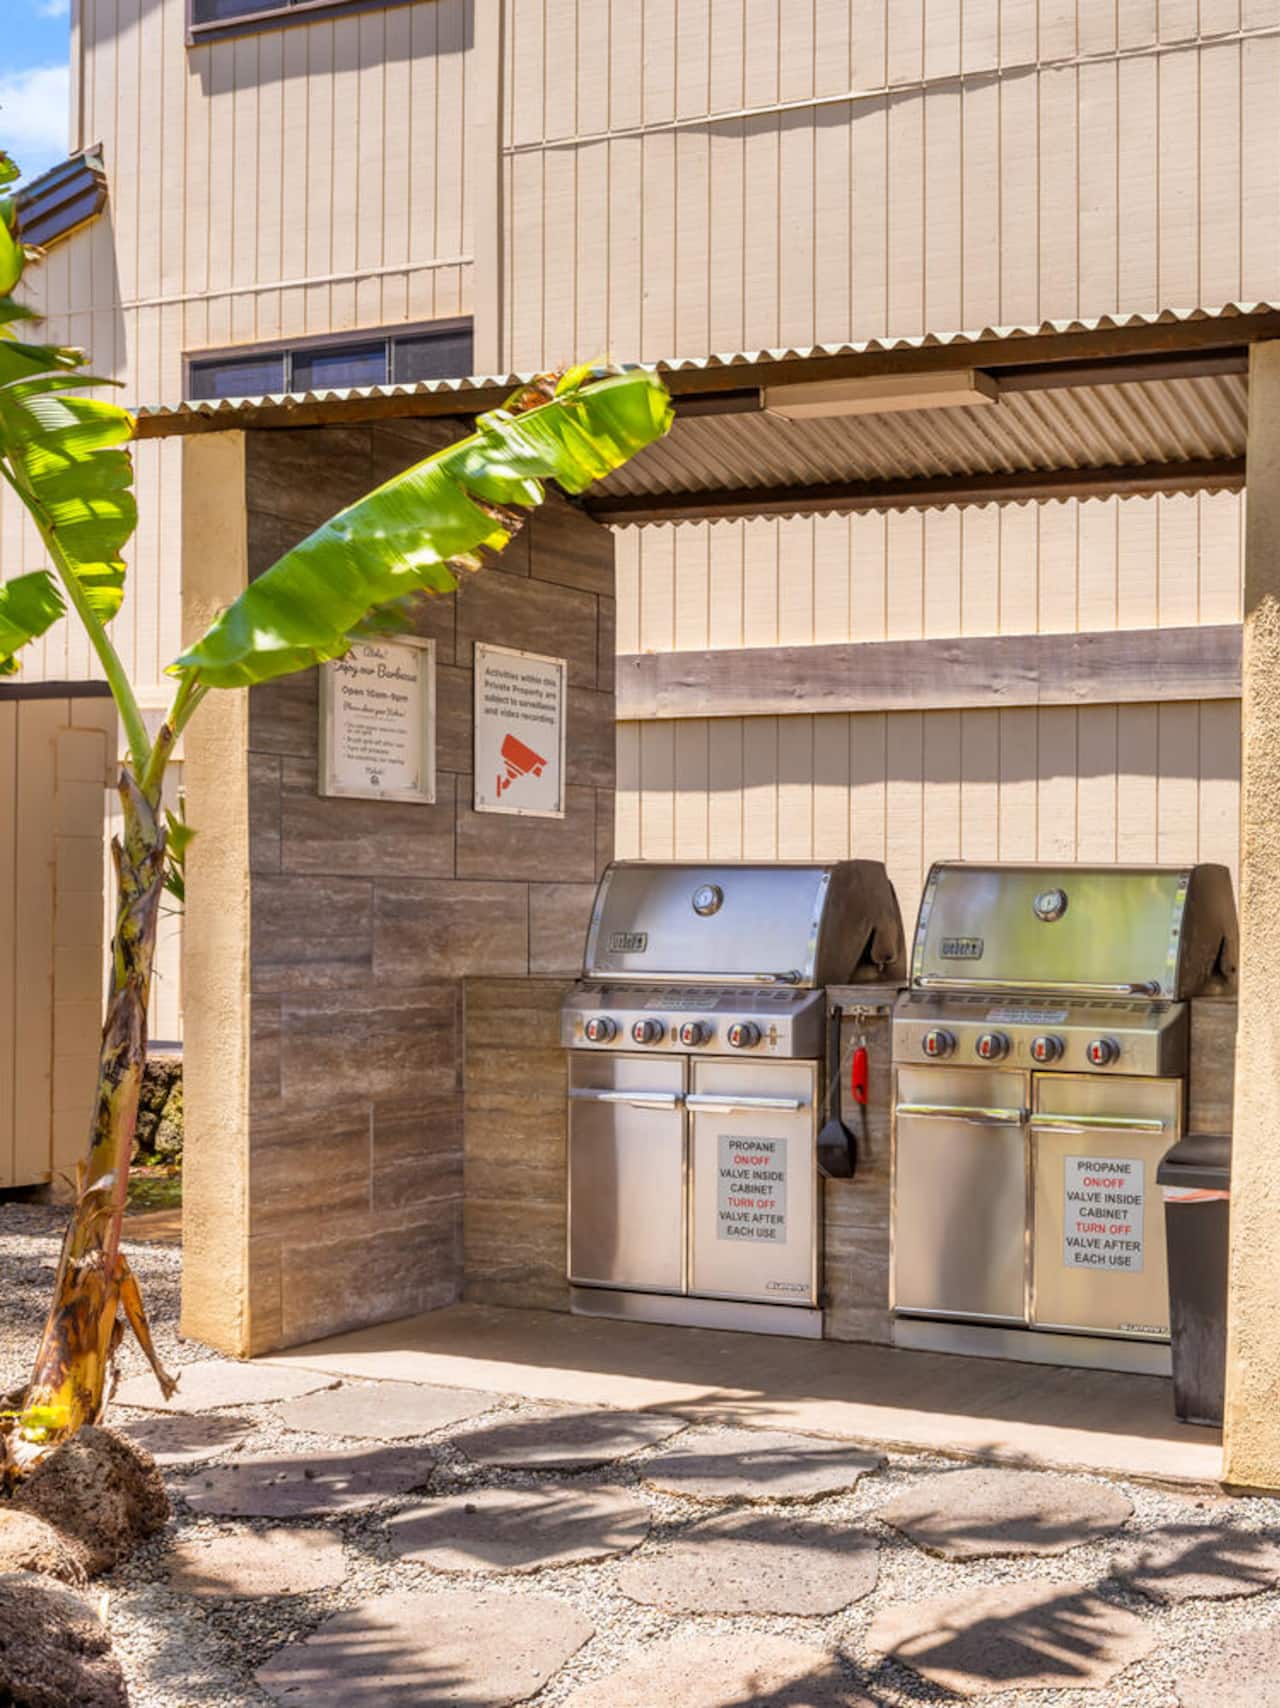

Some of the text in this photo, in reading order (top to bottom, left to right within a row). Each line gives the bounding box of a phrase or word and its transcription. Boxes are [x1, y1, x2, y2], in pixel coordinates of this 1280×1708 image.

[485, 667, 556, 687] Activities within this
[341, 685, 364, 697] Open
[485, 680, 510, 692] Private
[512, 685, 543, 698] Property
[484, 695, 509, 705] subject
[511, 698, 517, 706] to
[484, 708, 498, 716] and
[501, 710, 519, 719] video
[729, 1141, 776, 1152] PROPANE
[1077, 1162, 1132, 1174] PROPANE
[720, 1169, 785, 1182] VALVE INSIDE
[730, 1184, 774, 1195] CABINET
[728, 1197, 776, 1209] TURN OFF
[1067, 1192, 1142, 1205] VALVE INSIDE
[719, 1211, 785, 1225] VALVE AFTER
[1079, 1207, 1129, 1219] CABINET
[727, 1226, 777, 1239] EACH USE
[1076, 1222, 1132, 1235] TURN OFF
[1066, 1237, 1141, 1252] VALVE AFTER
[1074, 1252, 1132, 1266] EACH USE
